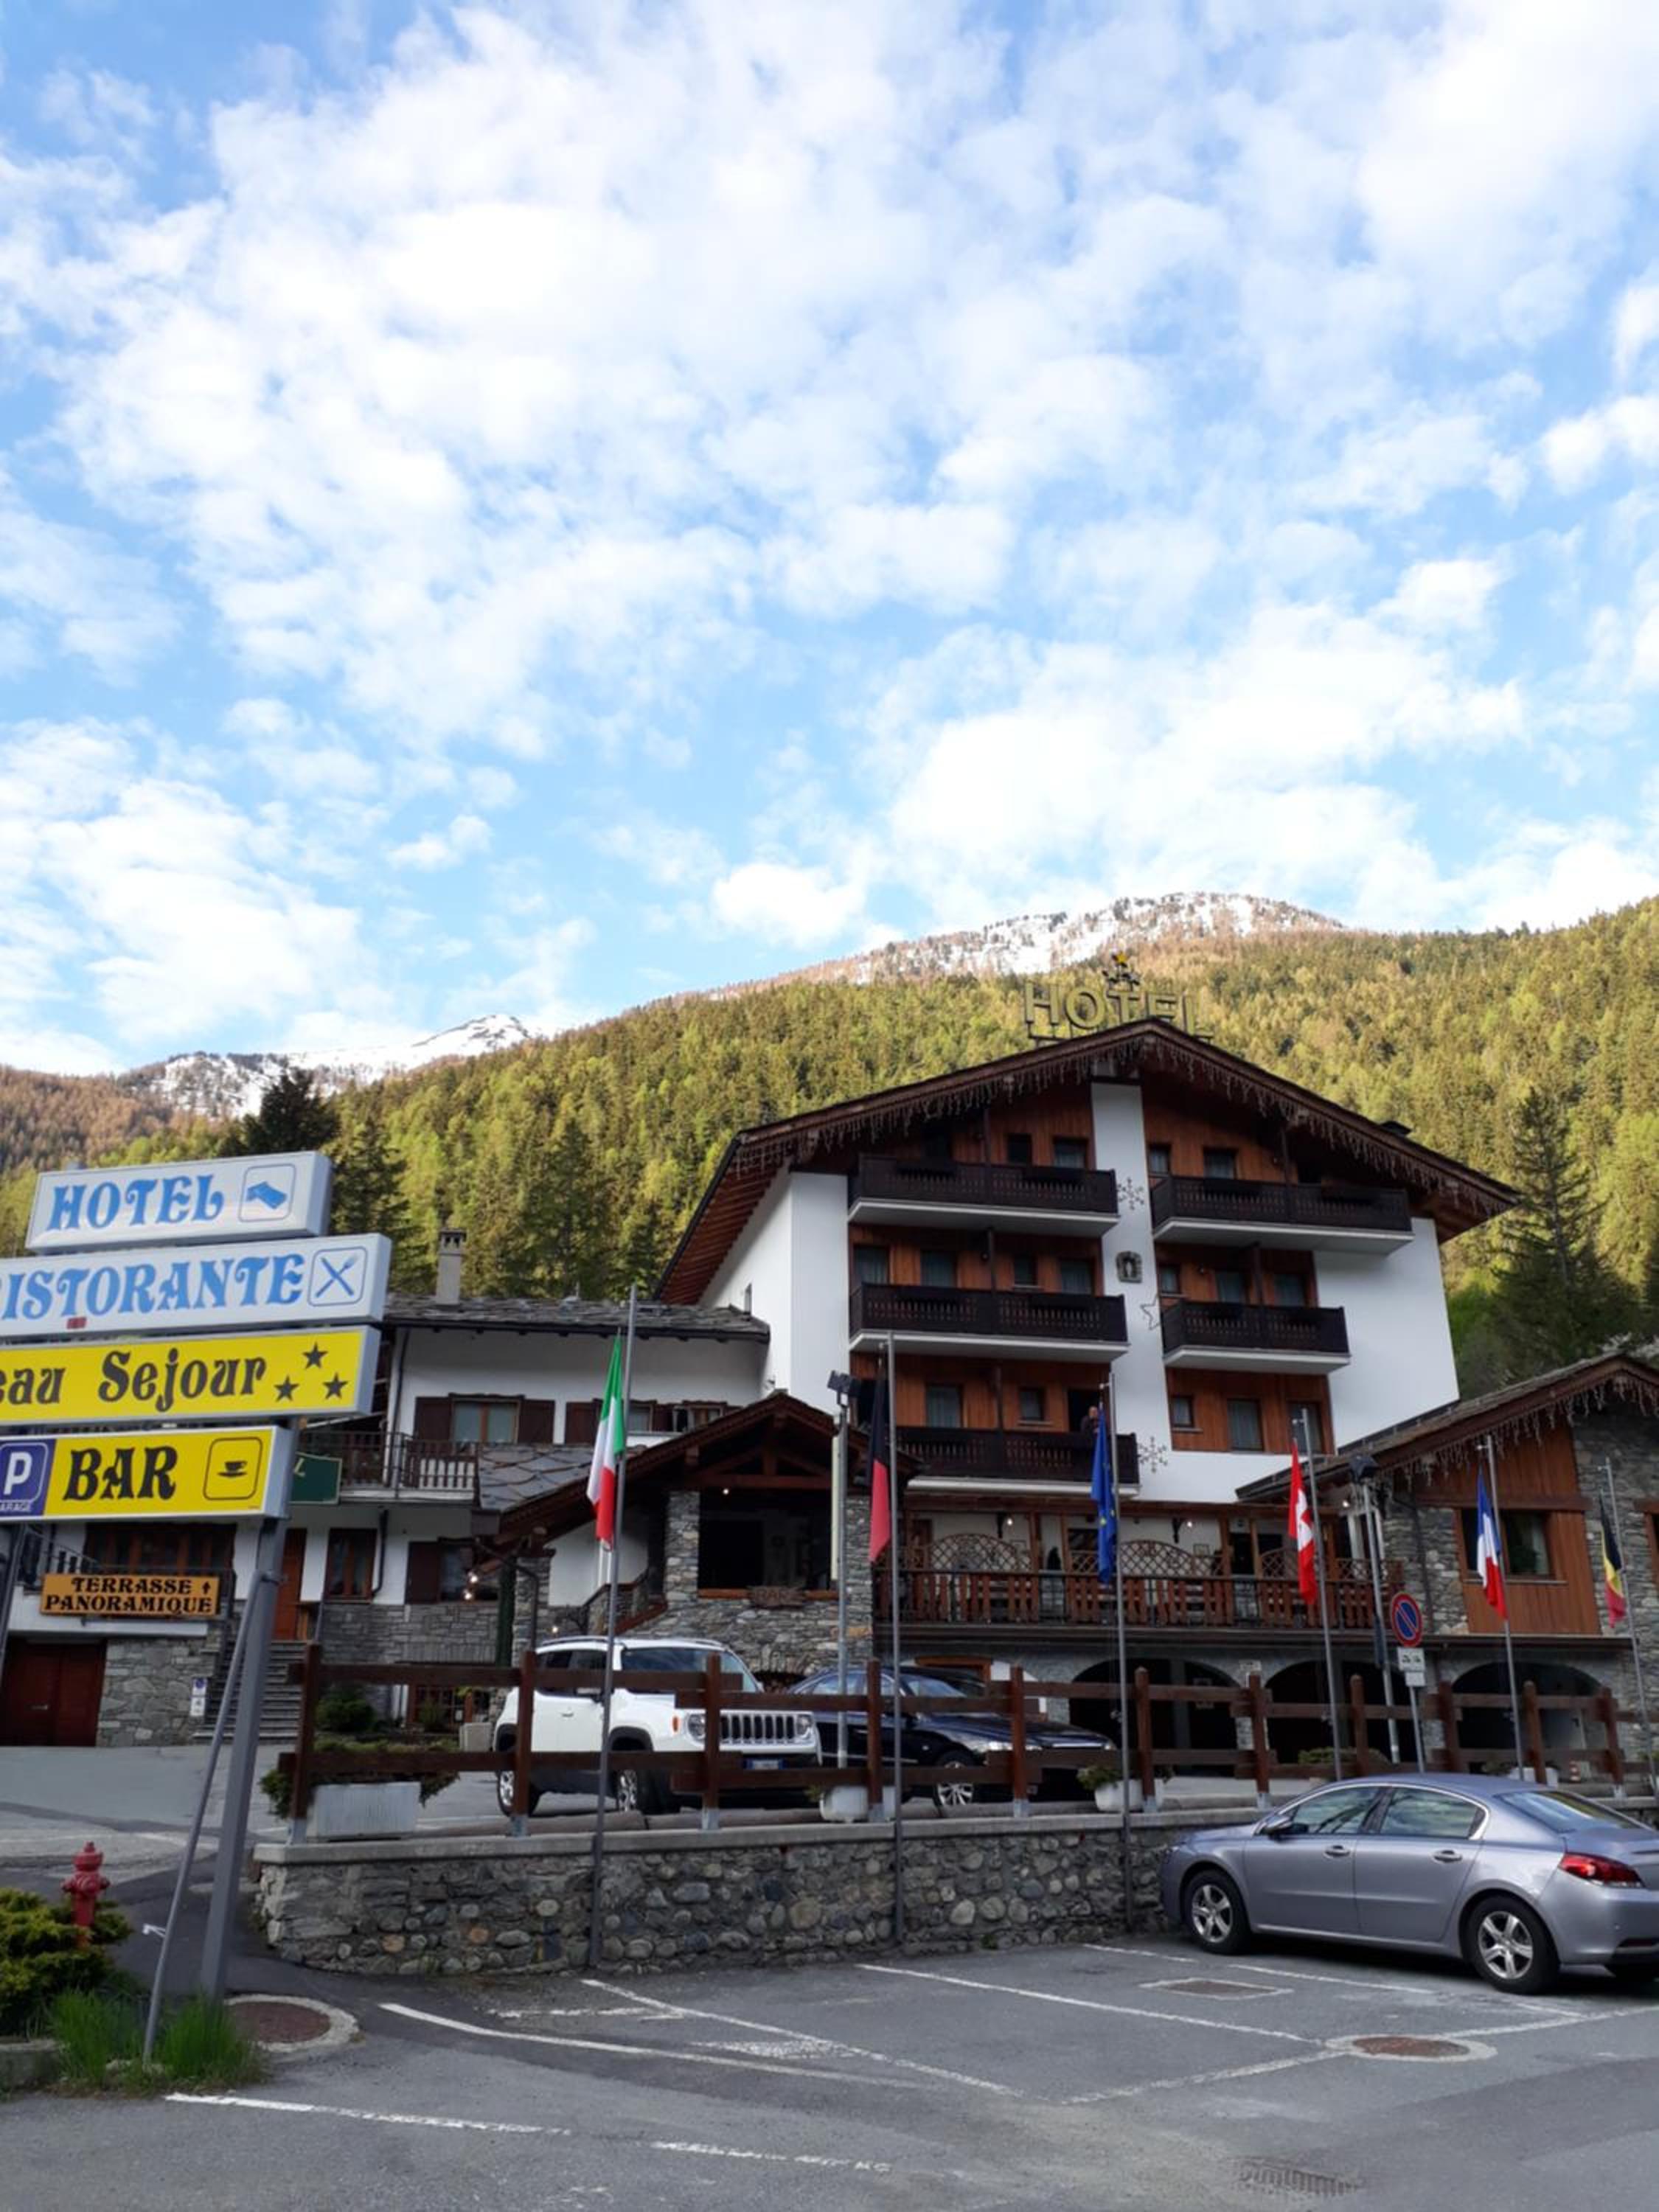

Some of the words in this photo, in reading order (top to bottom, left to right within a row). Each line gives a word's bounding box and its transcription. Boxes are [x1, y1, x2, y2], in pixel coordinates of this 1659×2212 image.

[1023, 979, 1214, 1038] HOTEL
[46, 1174, 223, 1232] HOTEL
[0, 1253, 305, 1320] ISTORANTE
[98, 1347, 267, 1413] Sejour
[3, 1451, 32, 1495] P
[63, 1445, 178, 1501] BAR
[44, 1594, 212, 1615] PANORAMIQUE
[71, 1576, 192, 1594] TERRASSE
